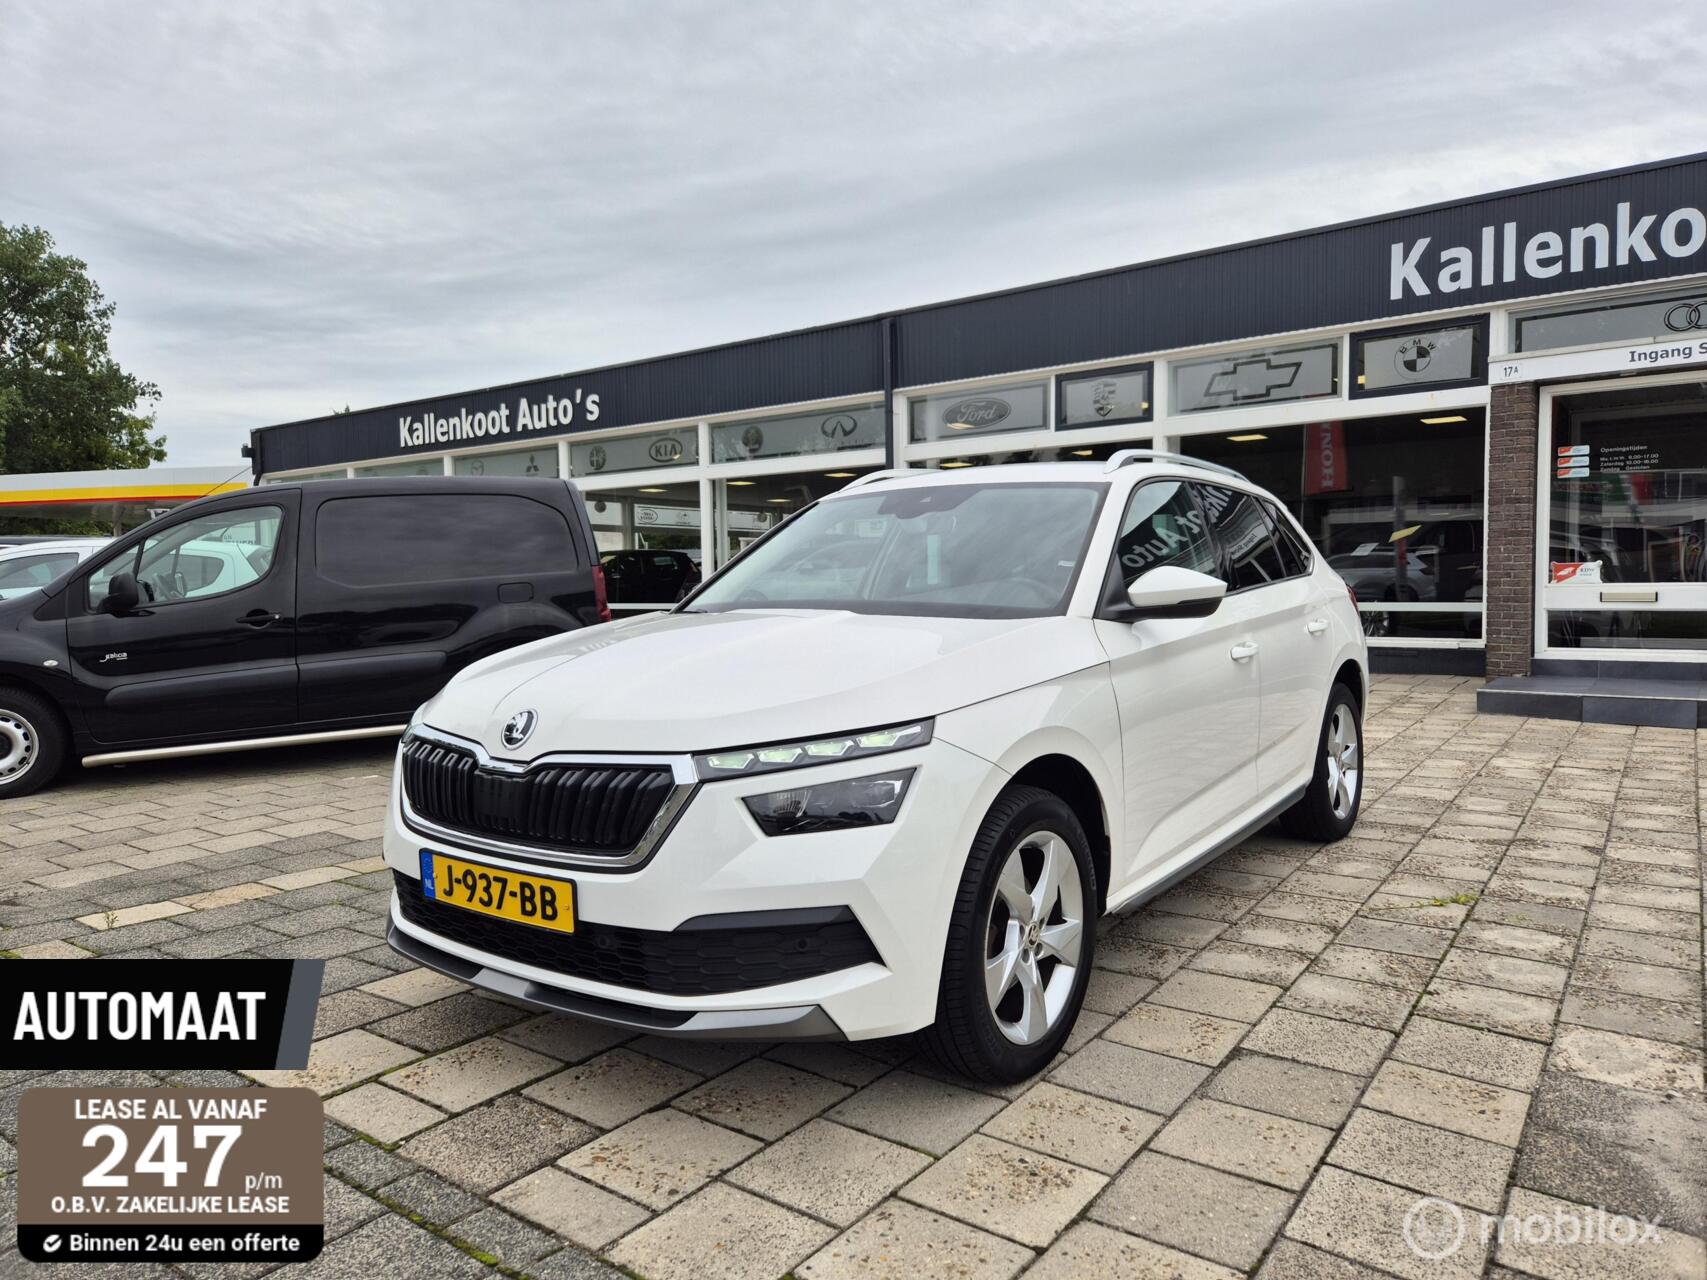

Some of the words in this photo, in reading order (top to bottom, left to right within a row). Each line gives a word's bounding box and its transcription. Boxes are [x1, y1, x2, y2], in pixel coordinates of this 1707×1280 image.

[1628, 346, 1693, 363] Ingang
[399, 402, 510, 448] Kallenkoot
[516, 388, 600, 433] Auto's
[424, 878, 434, 890] NL
[443, 865, 558, 921] J-937-BB
